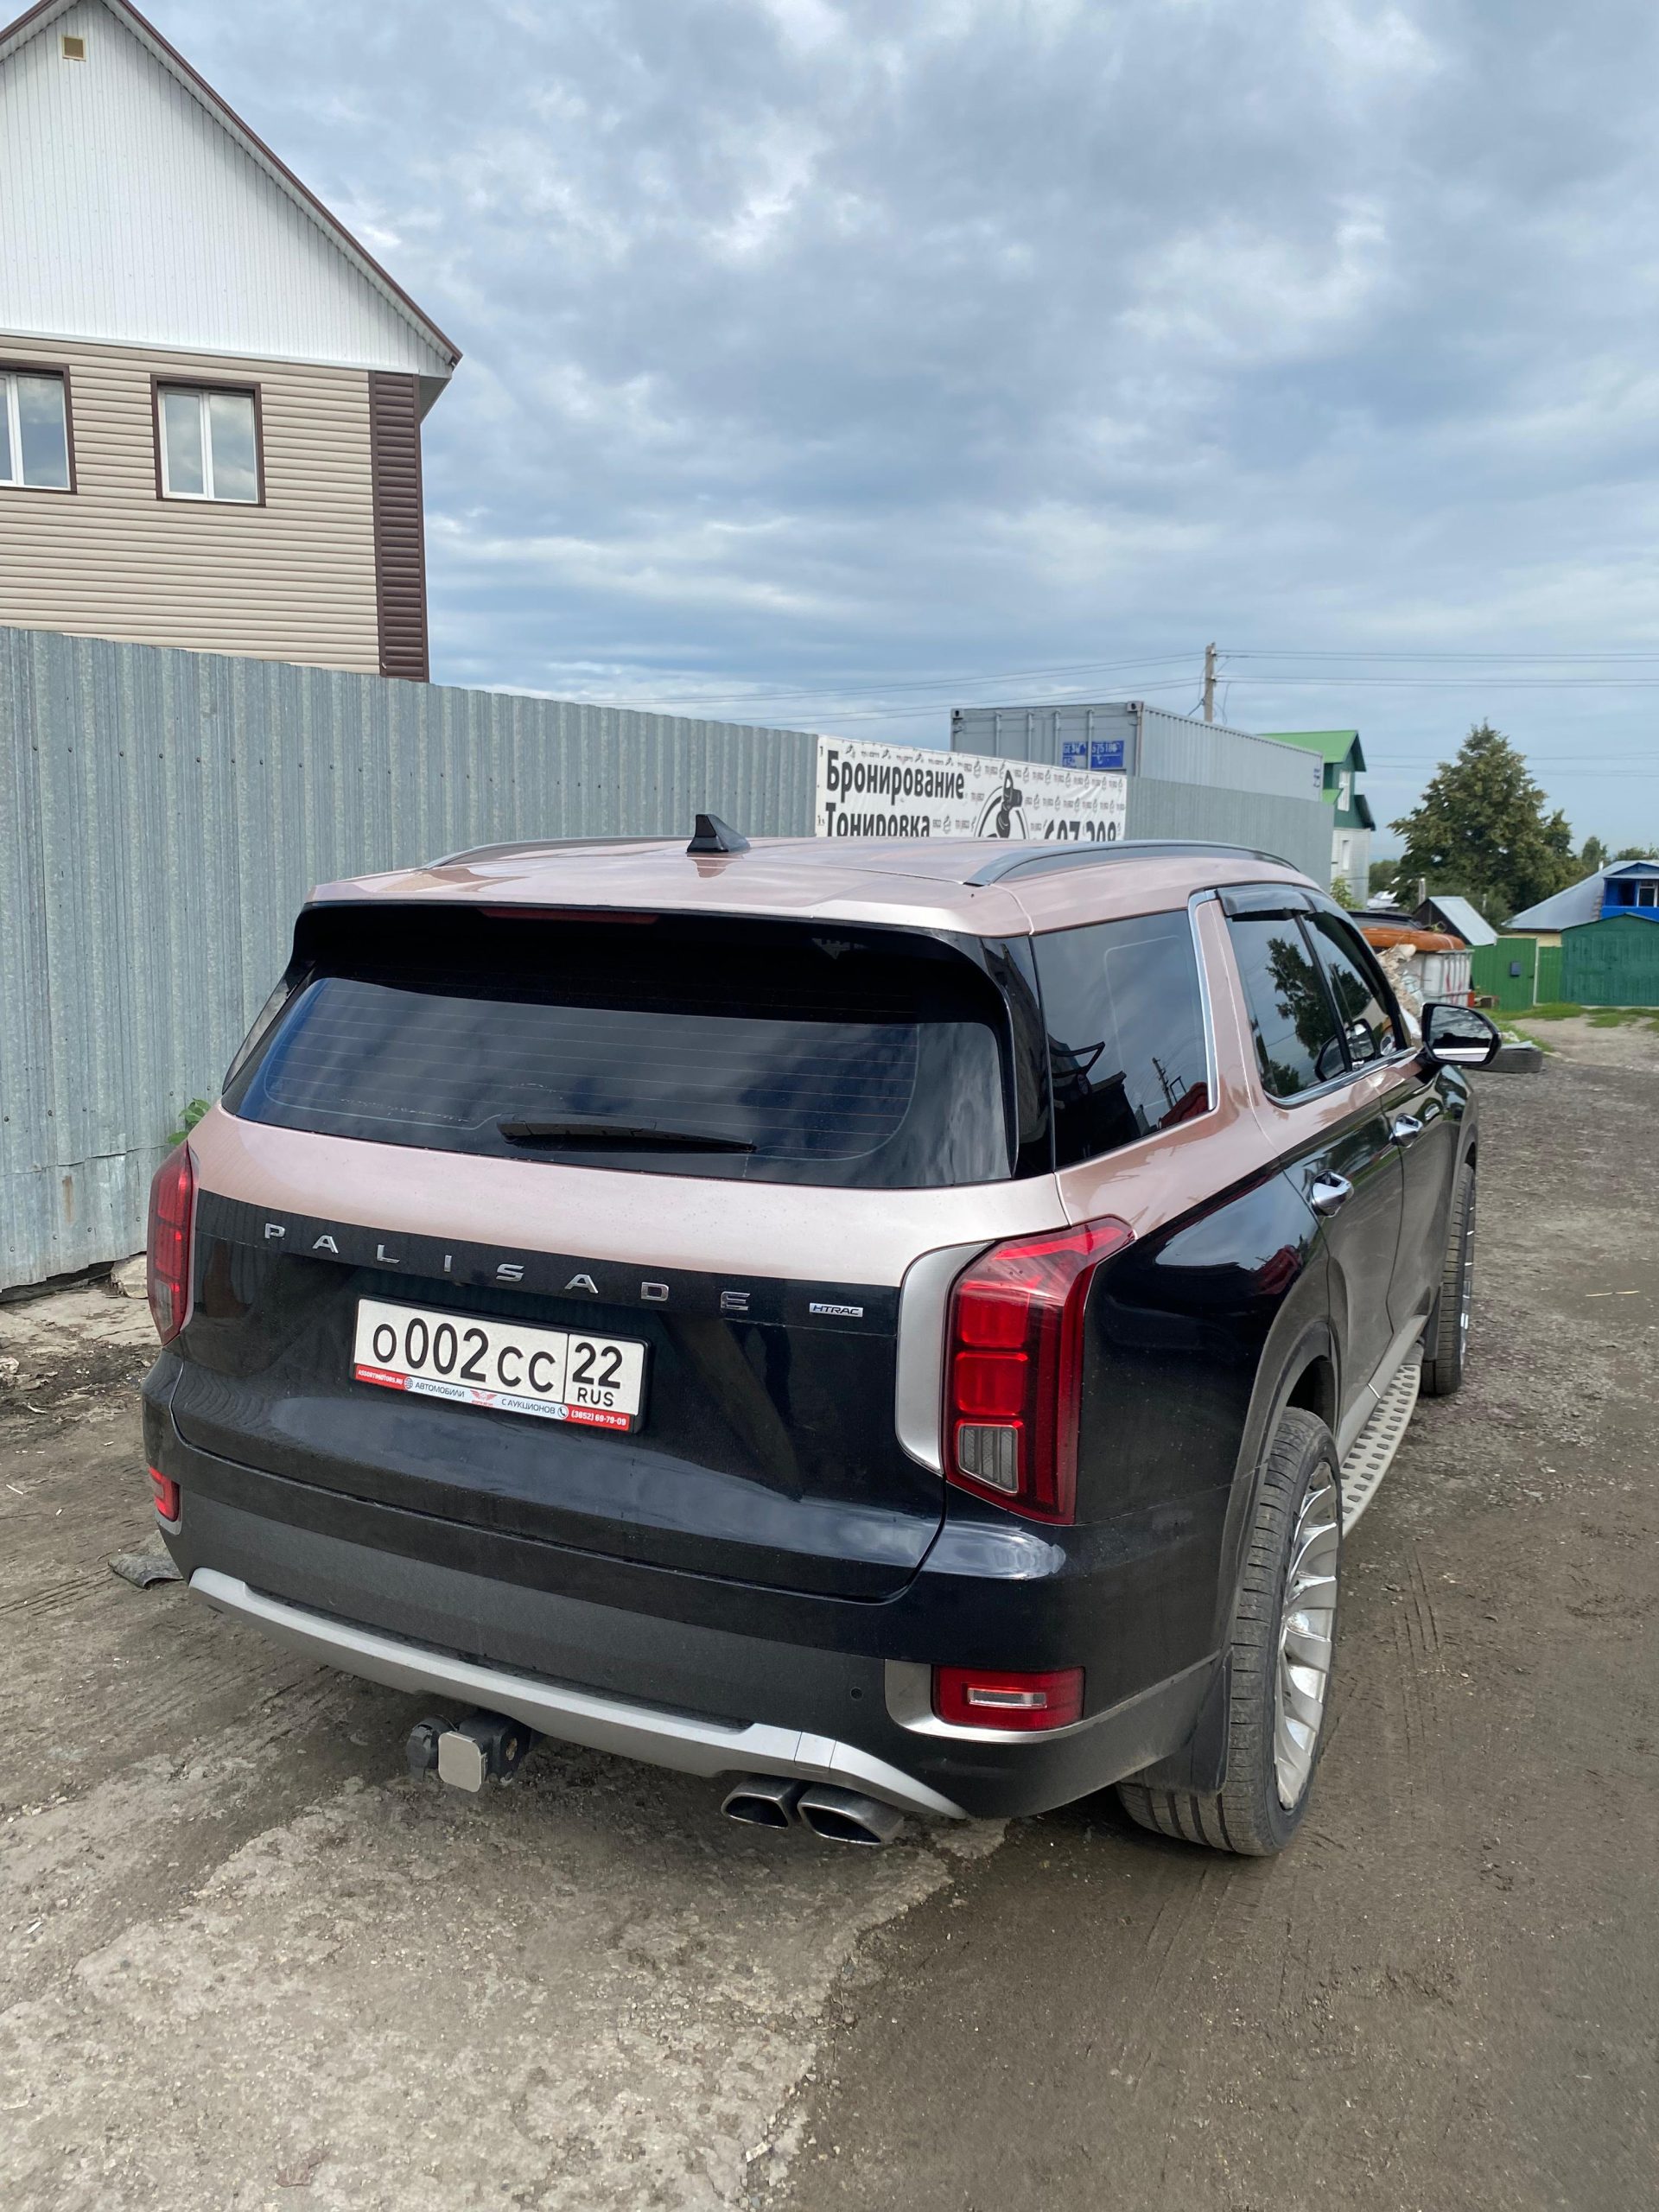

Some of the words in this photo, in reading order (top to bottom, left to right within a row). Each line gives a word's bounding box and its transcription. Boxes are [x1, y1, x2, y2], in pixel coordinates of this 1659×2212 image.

[827, 749, 964, 806] Бронирование
[825, 802, 931, 837] Тонировка
[264, 1223, 751, 1312] PALISADE
[812, 1305, 860, 1316] HTRAC
[572, 1342, 623, 1389] 22
[415, 1382, 465, 1398] АВТОМОБИЛИ
[507, 1400, 556, 1414] АУКЦИОНОВ
[577, 1387, 614, 1408] RUS
[571, 1409, 594, 1421] (3852)
[595, 1414, 627, 1426] 69-79-09
